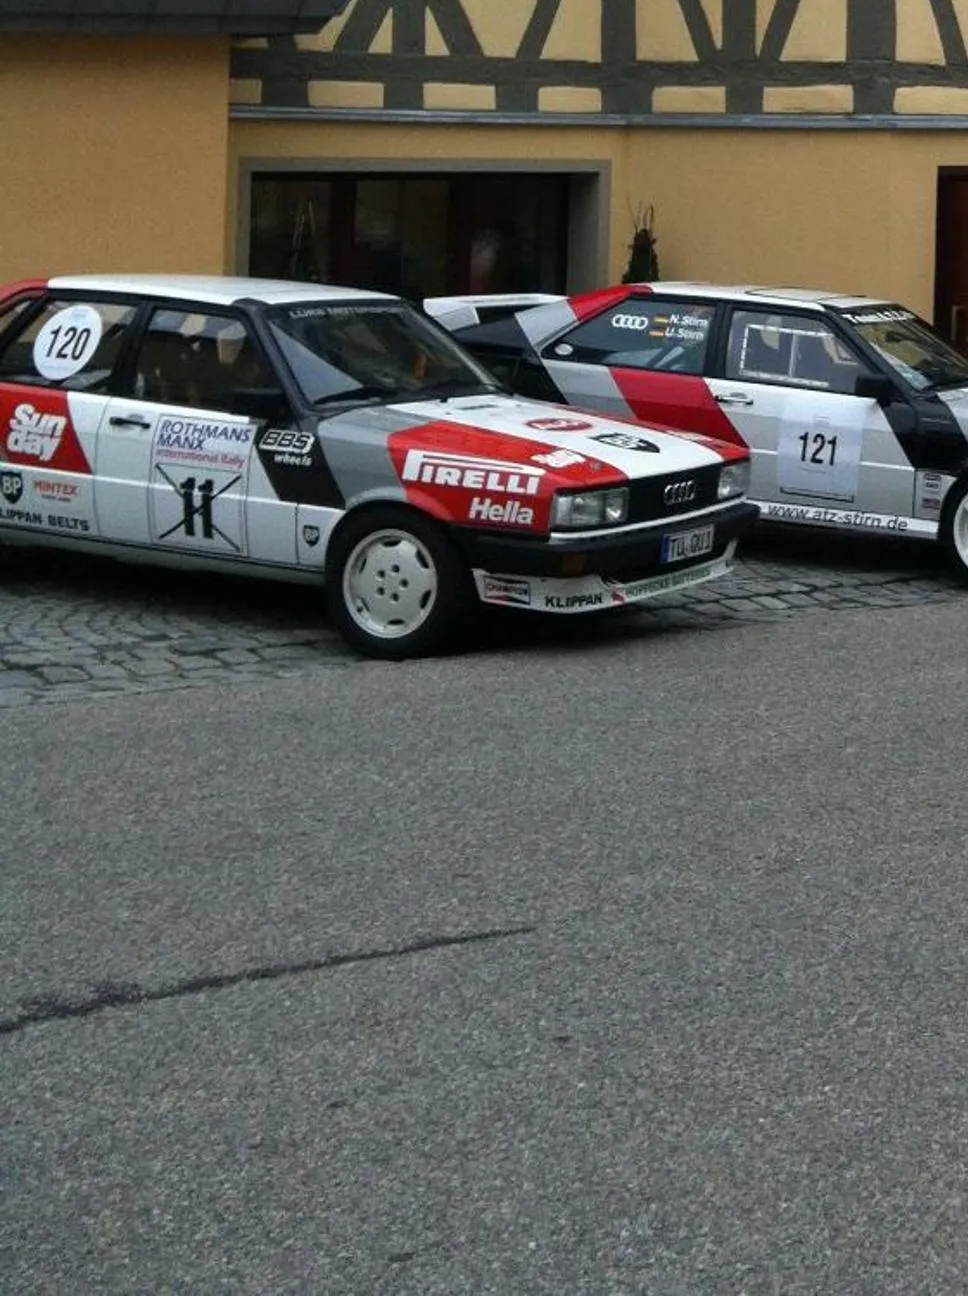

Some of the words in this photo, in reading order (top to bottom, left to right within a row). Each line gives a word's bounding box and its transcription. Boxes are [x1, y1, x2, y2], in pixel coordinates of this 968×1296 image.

[46, 325, 91, 361] 120
[10, 404, 67, 437] Sun
[161, 419, 251, 443] ROTHMANS
[157, 433, 204, 451] MANX
[260, 430, 314, 453] BBS
[799, 432, 838, 466] 121
[274, 454, 312, 467] wheels
[402, 449, 546, 496] PIRELLI
[34, 480, 78, 496] MINTEX
[180, 477, 214, 540] 11
[468, 497, 534, 525] Hella
[768, 505, 909, 531] www.atz-stirn.de
[48, 514, 90, 531] BELTS
[545, 592, 603, 608] KLIPPAN
